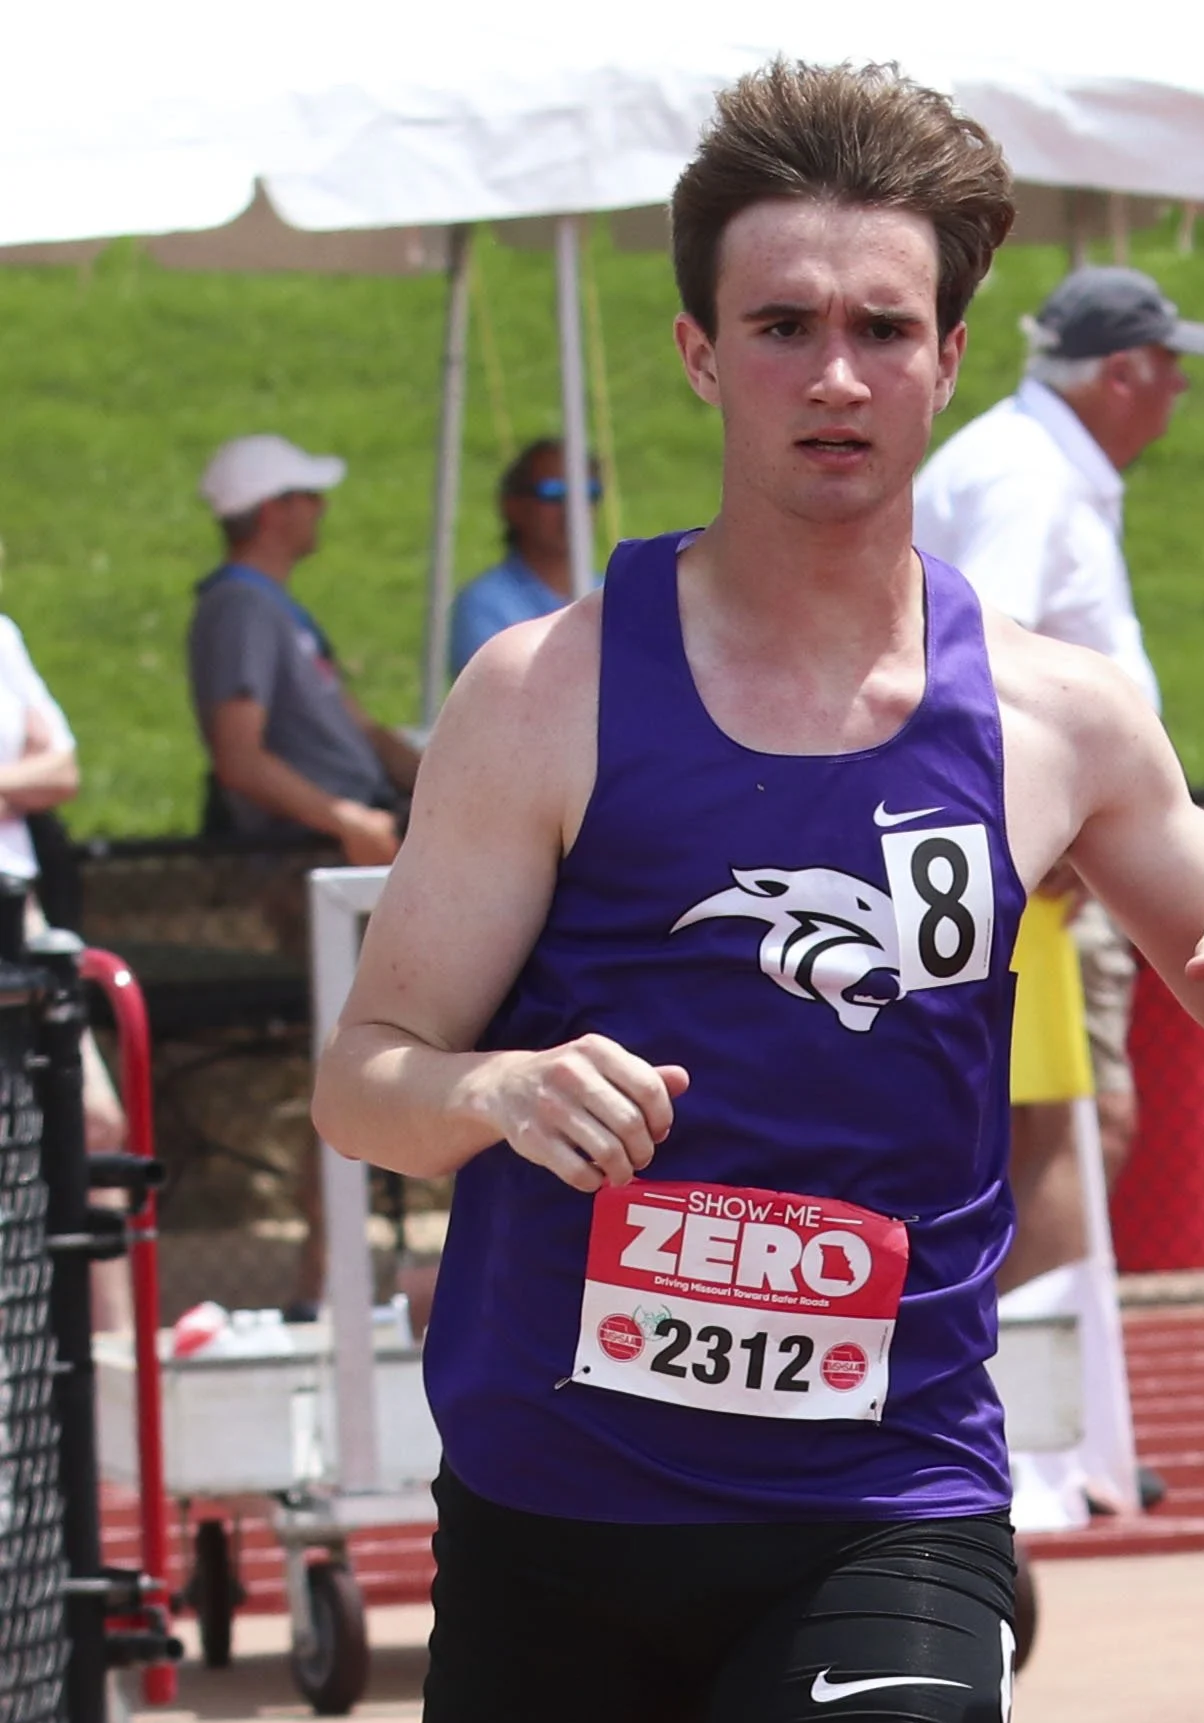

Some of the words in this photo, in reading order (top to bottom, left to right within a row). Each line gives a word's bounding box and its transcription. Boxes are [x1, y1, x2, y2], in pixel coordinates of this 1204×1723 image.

[911, 837, 976, 978] 8
[688, 1191, 822, 1228] SHOW-ME
[620, 1203, 872, 1297] ZERO
[654, 1275, 689, 1292] Driving
[691, 1282, 731, 1297] Missouri
[733, 1288, 770, 1302] Toward
[771, 1293, 798, 1305] Safer
[799, 1296, 830, 1308] Roads
[650, 1319, 814, 1392] 2312
